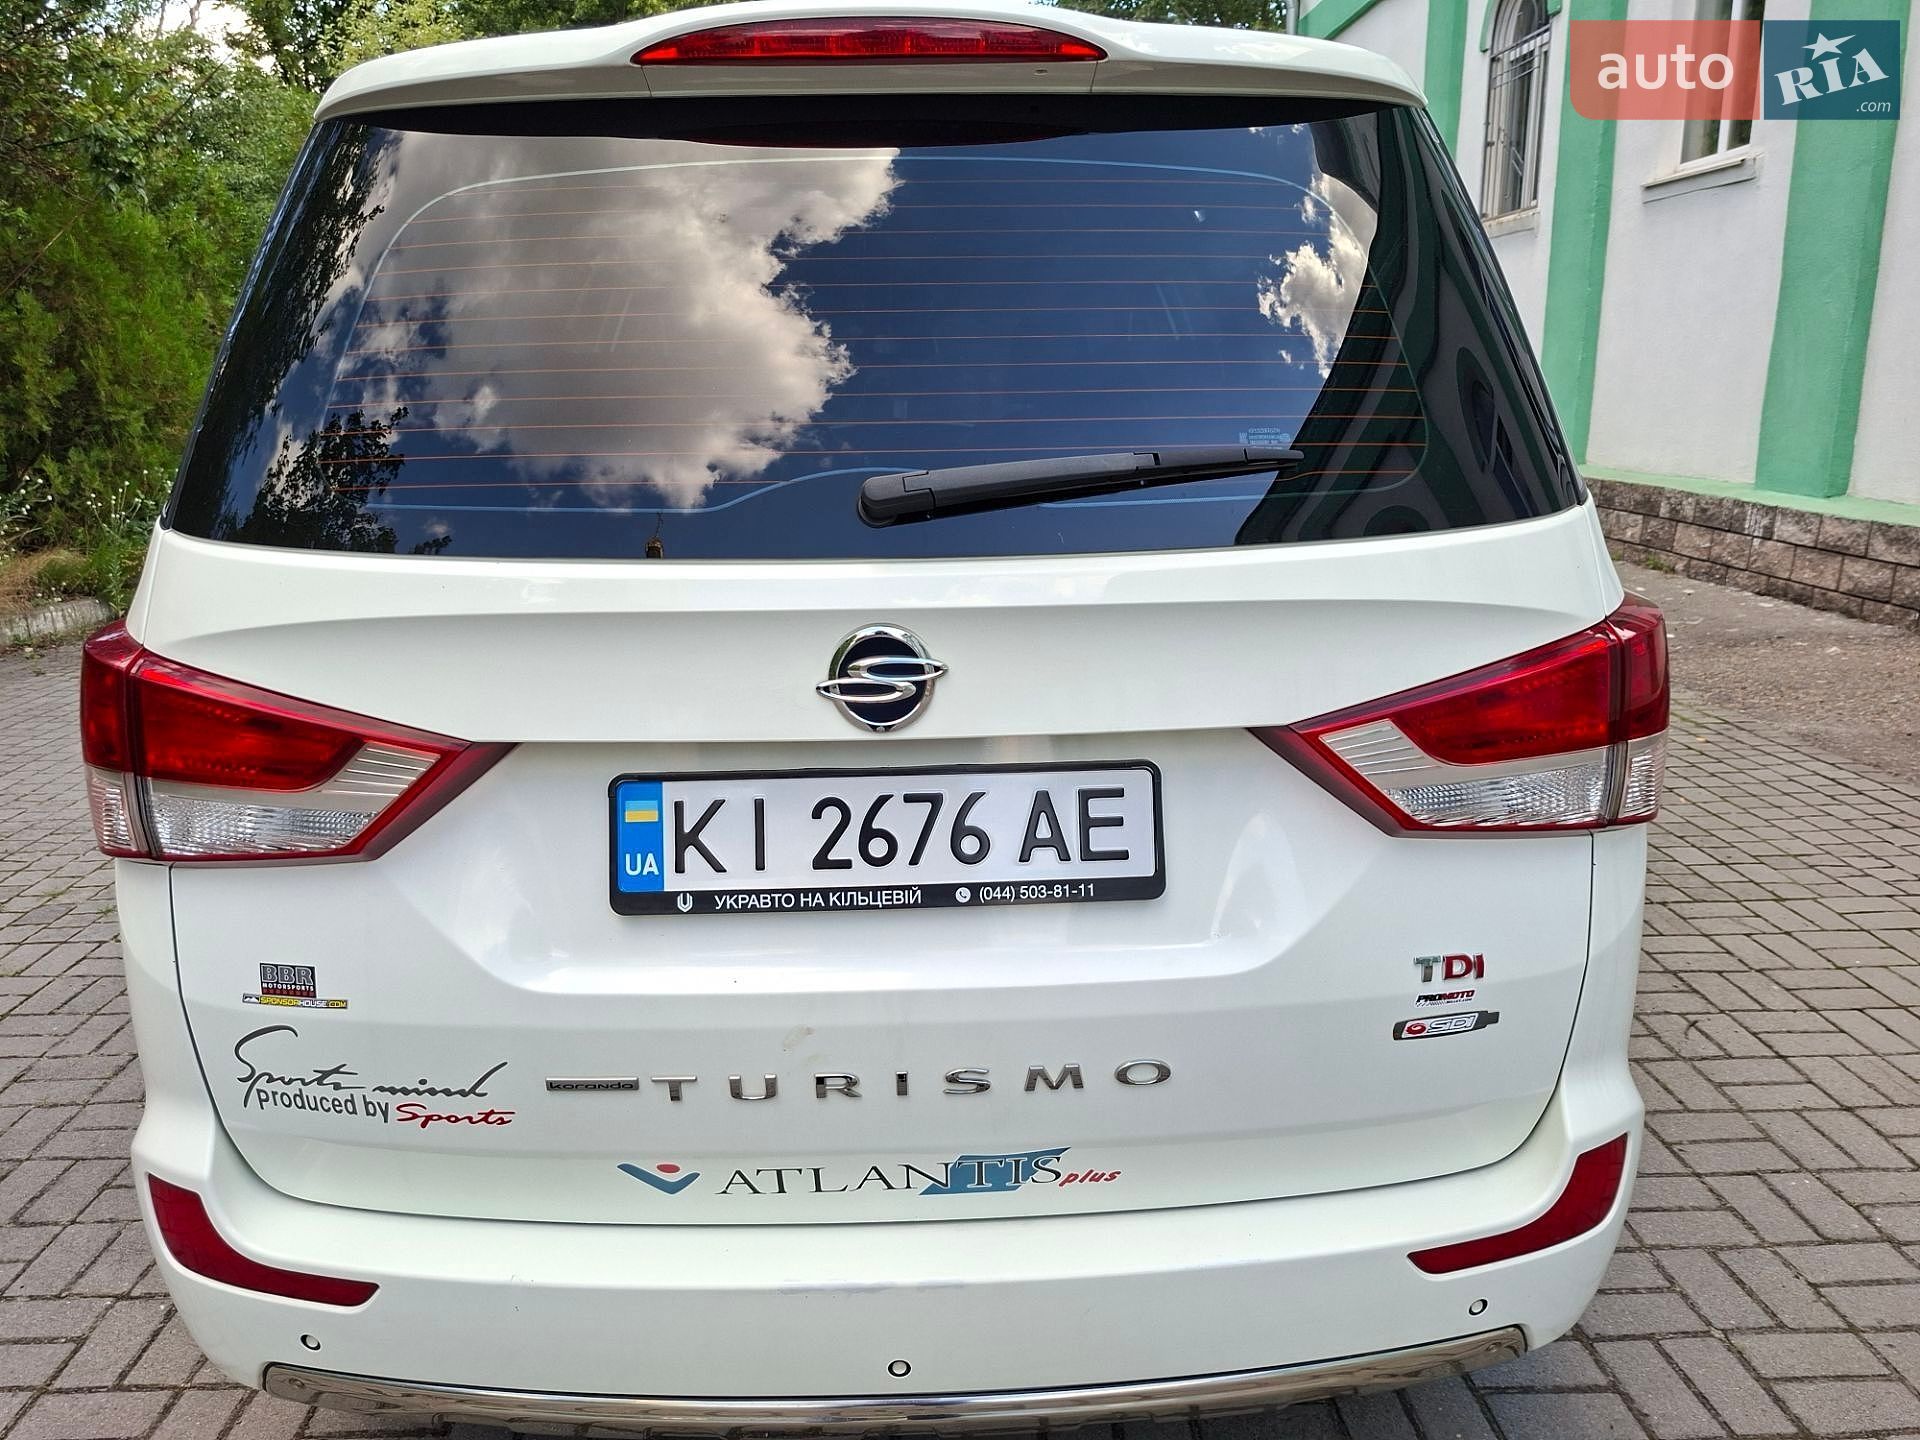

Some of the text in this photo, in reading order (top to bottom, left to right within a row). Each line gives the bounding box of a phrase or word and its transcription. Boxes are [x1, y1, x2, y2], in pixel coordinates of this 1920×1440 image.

[811, 791, 991, 870] 2676
[1017, 786, 1130, 862] AE
[625, 853, 660, 876] UA
[714, 886, 922, 910] УКРАВТО НА КІЛЬЦЕВІЙ
[978, 883, 1095, 902] (044) 503-81-11
[260, 964, 314, 985] BBR
[1413, 953, 1485, 982] TDI
[262, 982, 315, 991] MOTORSPORTS
[234, 1025, 508, 1108] Sports mind
[549, 1059, 1173, 1102] korando TURISMO
[256, 1088, 516, 1128] produced by Sports
[715, 1155, 1123, 1195] ATLANTIS plus
